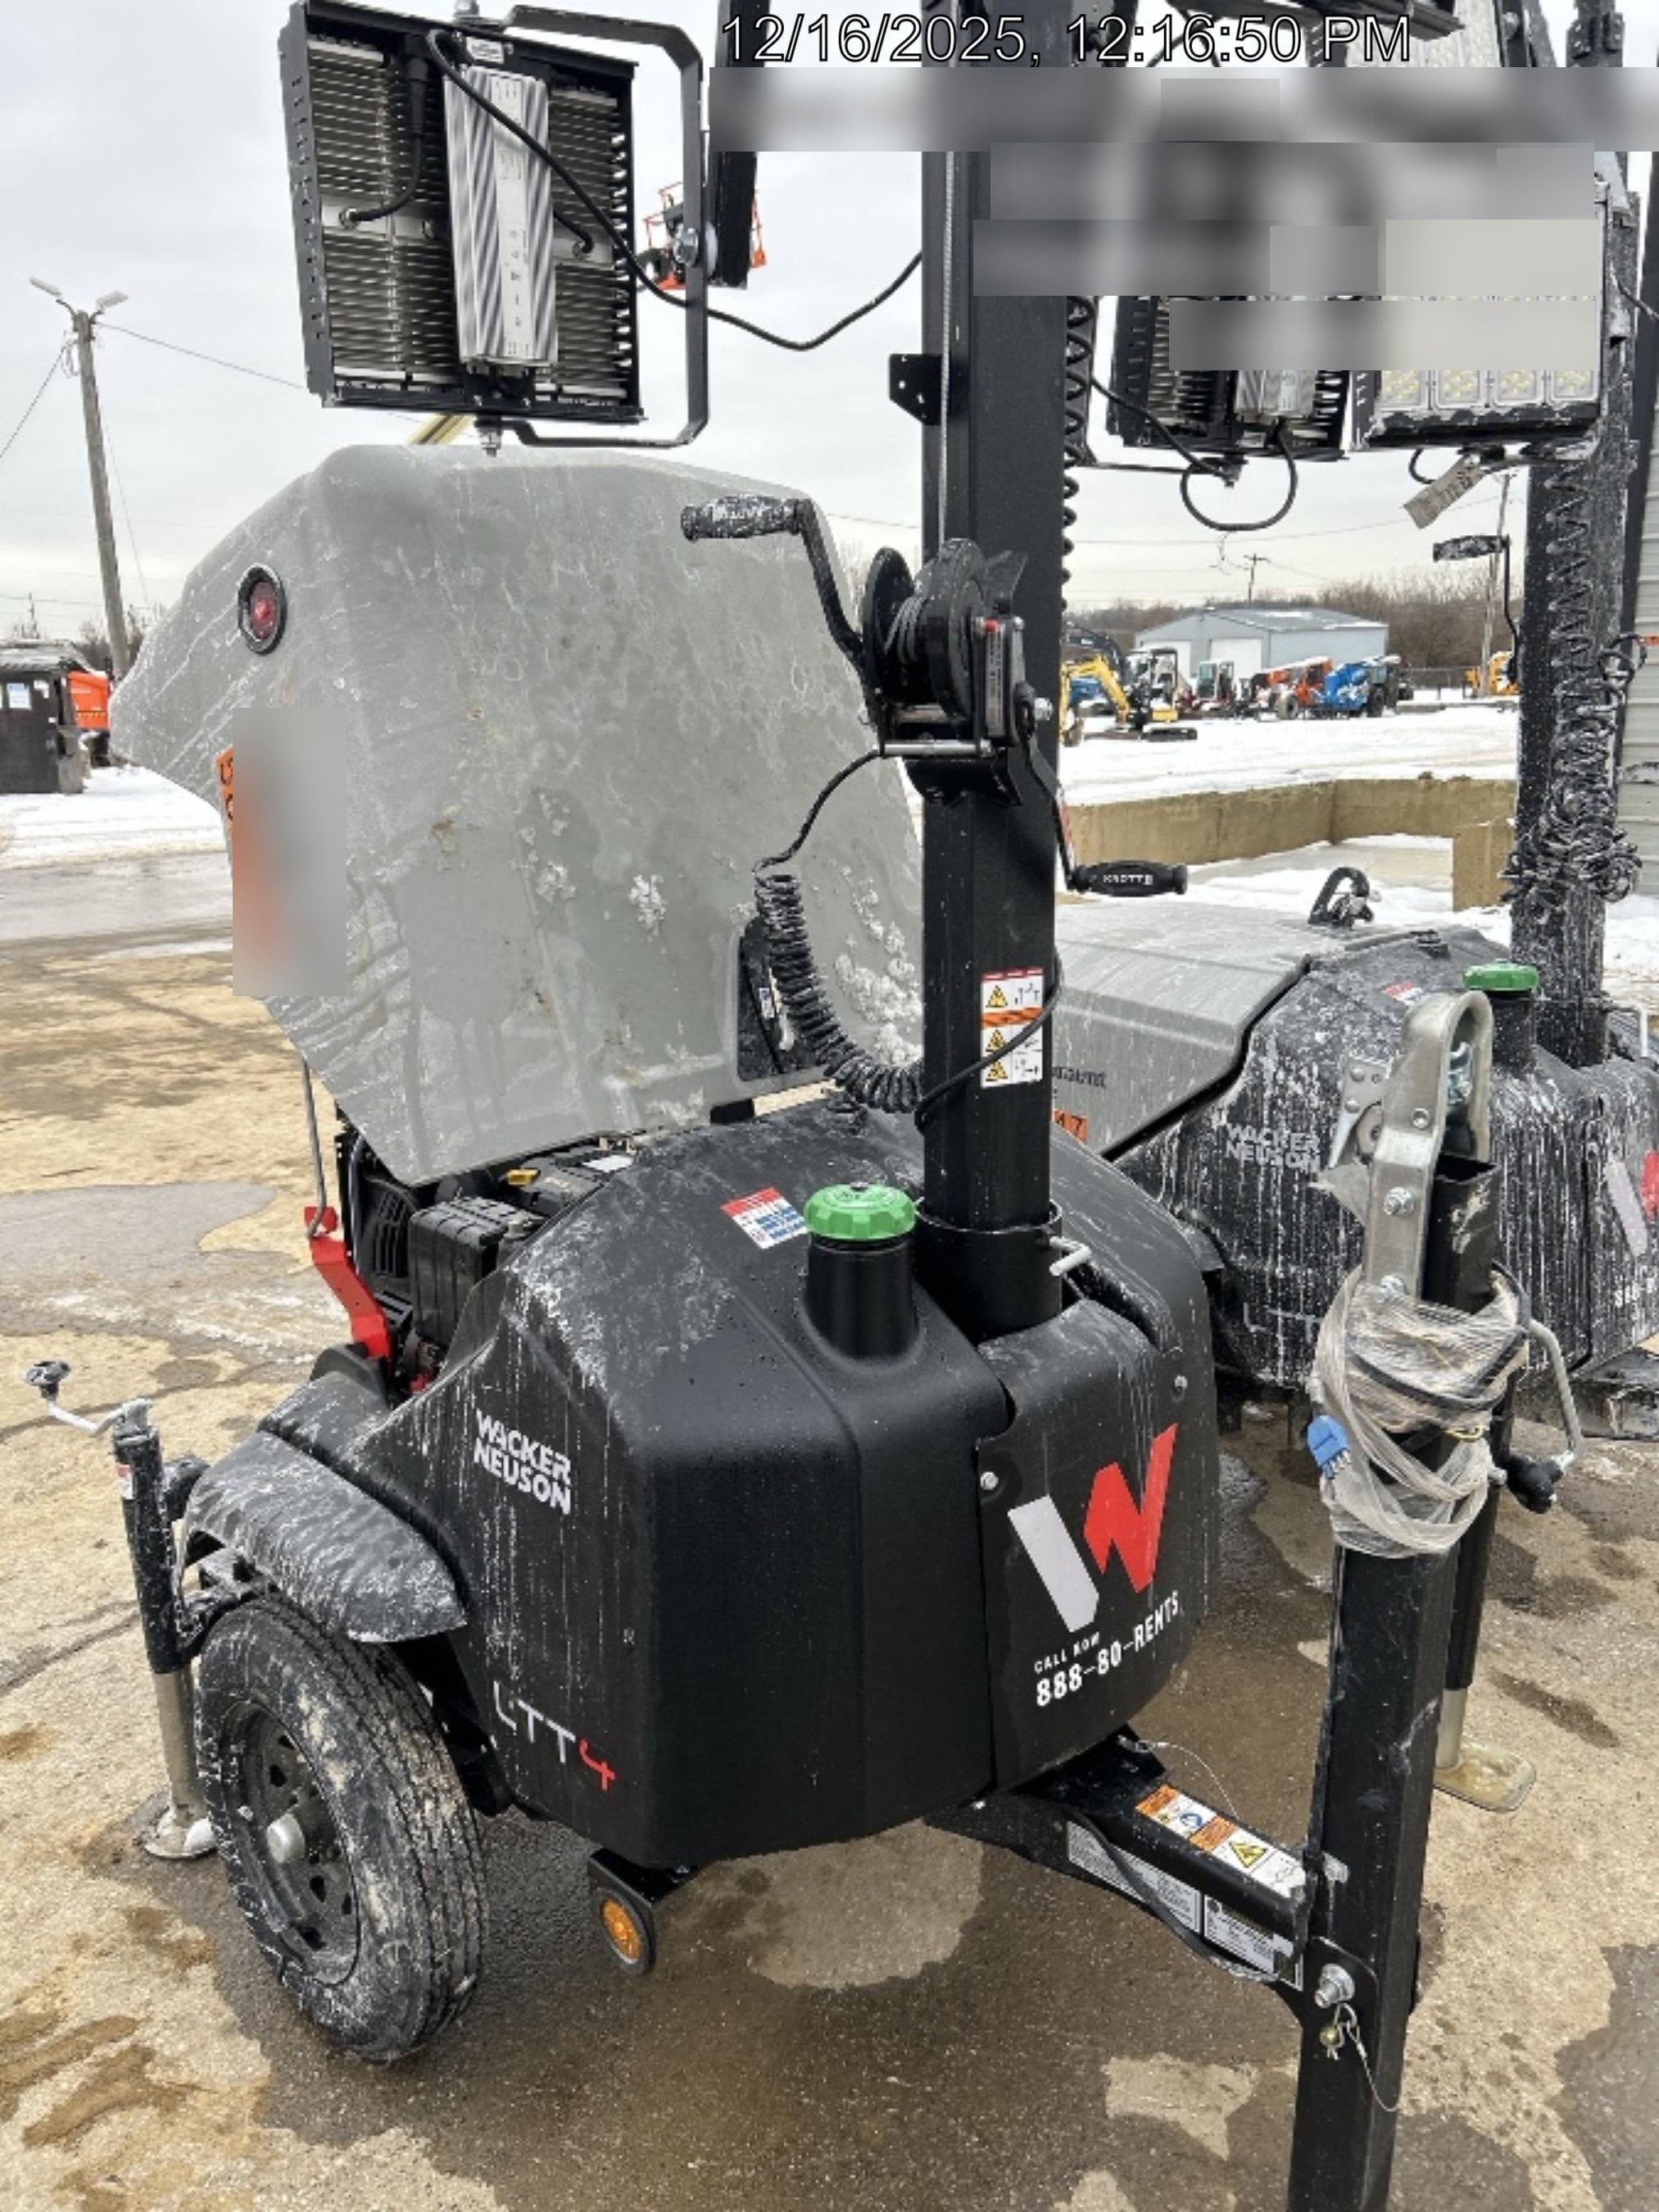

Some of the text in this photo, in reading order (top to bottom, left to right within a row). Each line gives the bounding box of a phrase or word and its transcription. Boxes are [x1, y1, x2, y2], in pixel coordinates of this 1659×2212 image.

[1226, 1122, 1321, 1156] WACKER
[1226, 1140, 1321, 1172] NEUSON
[474, 1436, 571, 1515] NEUSON
[475, 1407, 571, 1486] WACKER
[1034, 1631, 1100, 1675] CALL NOW
[1036, 1589, 1179, 1707] 888-80-RENTS
[492, 1679, 616, 1792] LTT4
